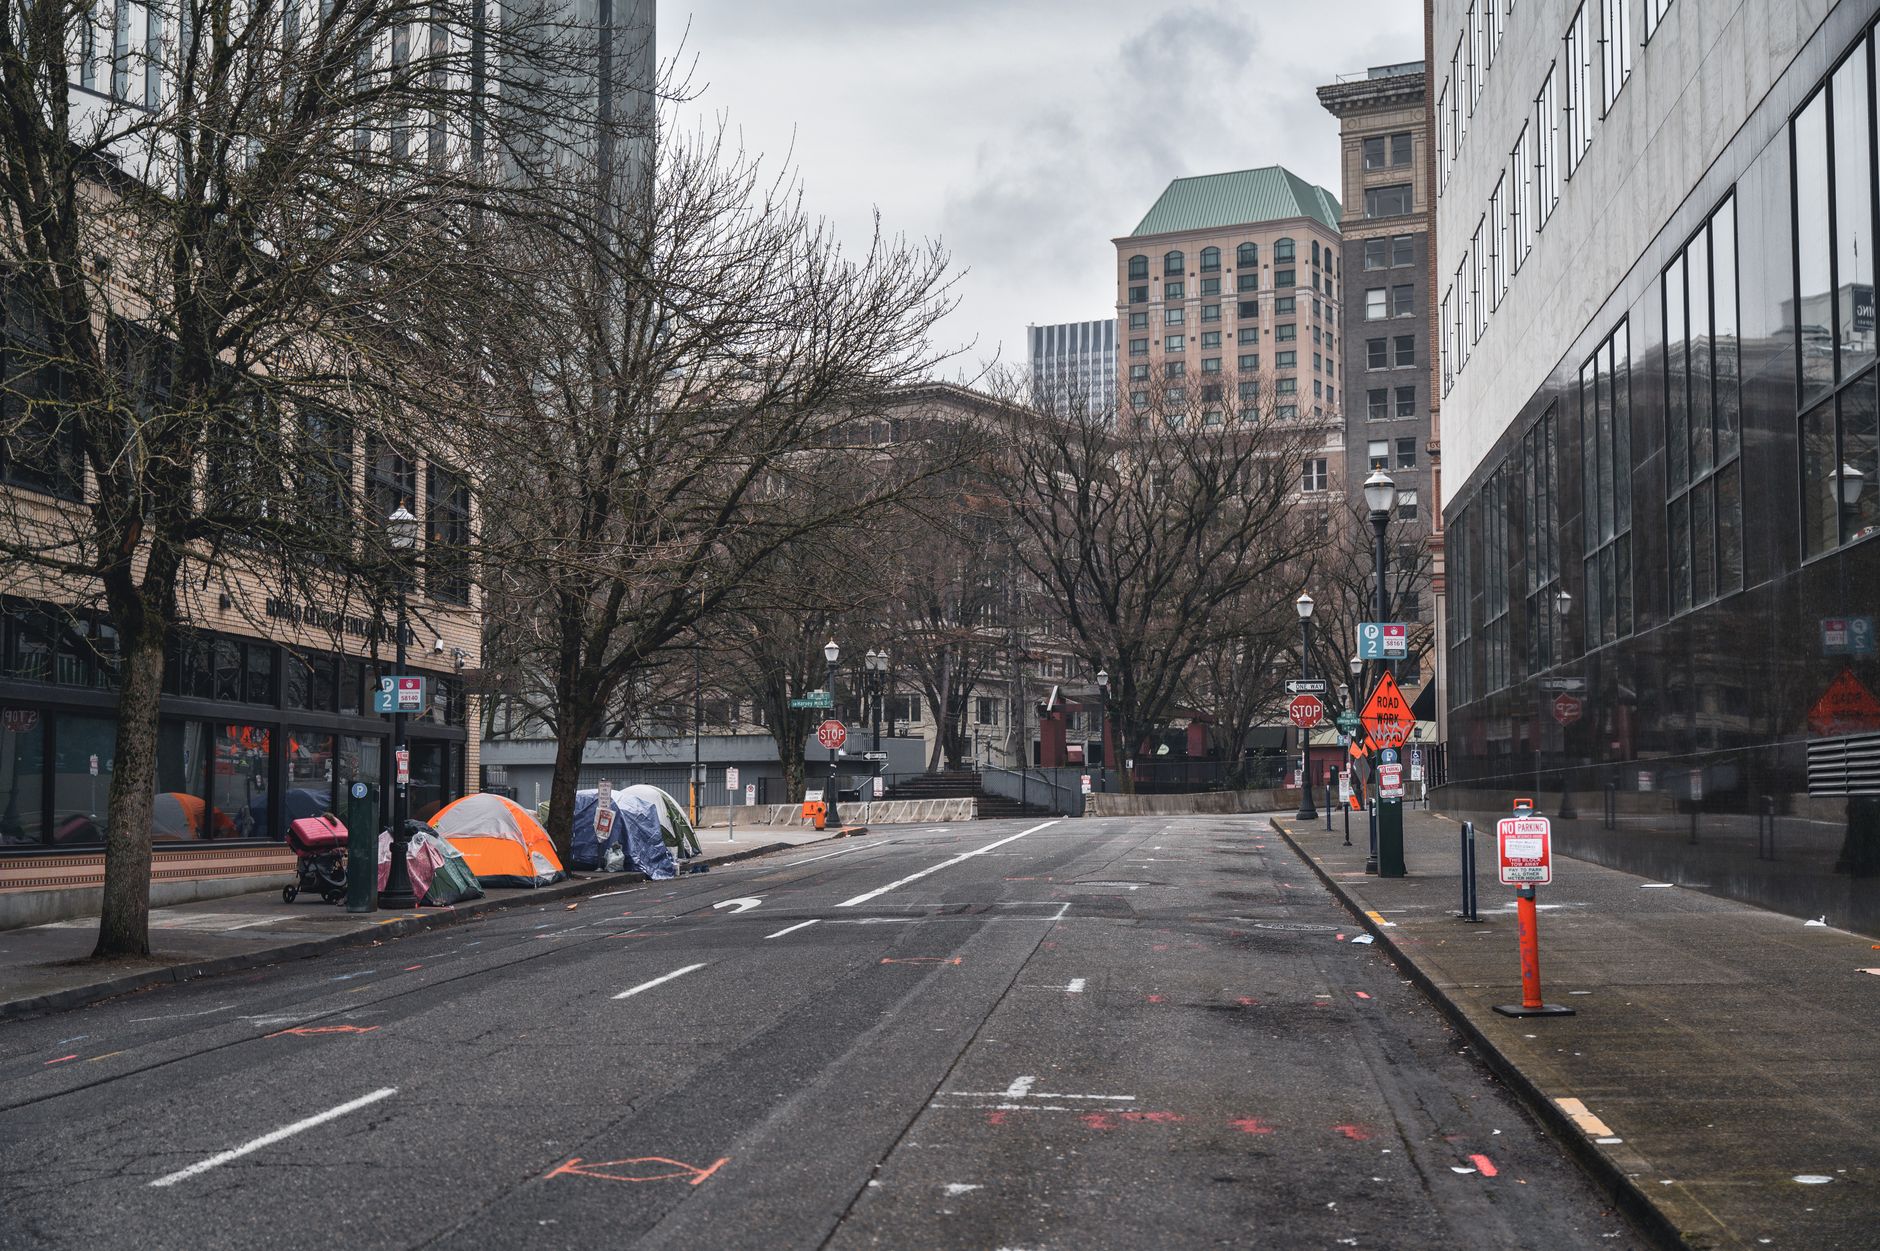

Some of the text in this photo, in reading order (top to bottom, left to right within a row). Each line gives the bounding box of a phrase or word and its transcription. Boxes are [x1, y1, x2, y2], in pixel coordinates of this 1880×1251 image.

[1368, 626, 1376, 637] P
[1367, 640, 1377, 653] 2
[384, 680, 392, 690] P
[382, 694, 392, 707] 2
[1377, 696, 1399, 708] ROAD
[1292, 705, 1320, 718] STOP
[1376, 713, 1399, 725] WORK
[820, 729, 844, 740] STOP
[1386, 752, 1393, 761] P
[357, 785, 364, 796] P
[1502, 823, 1544, 834] NO PARKING
